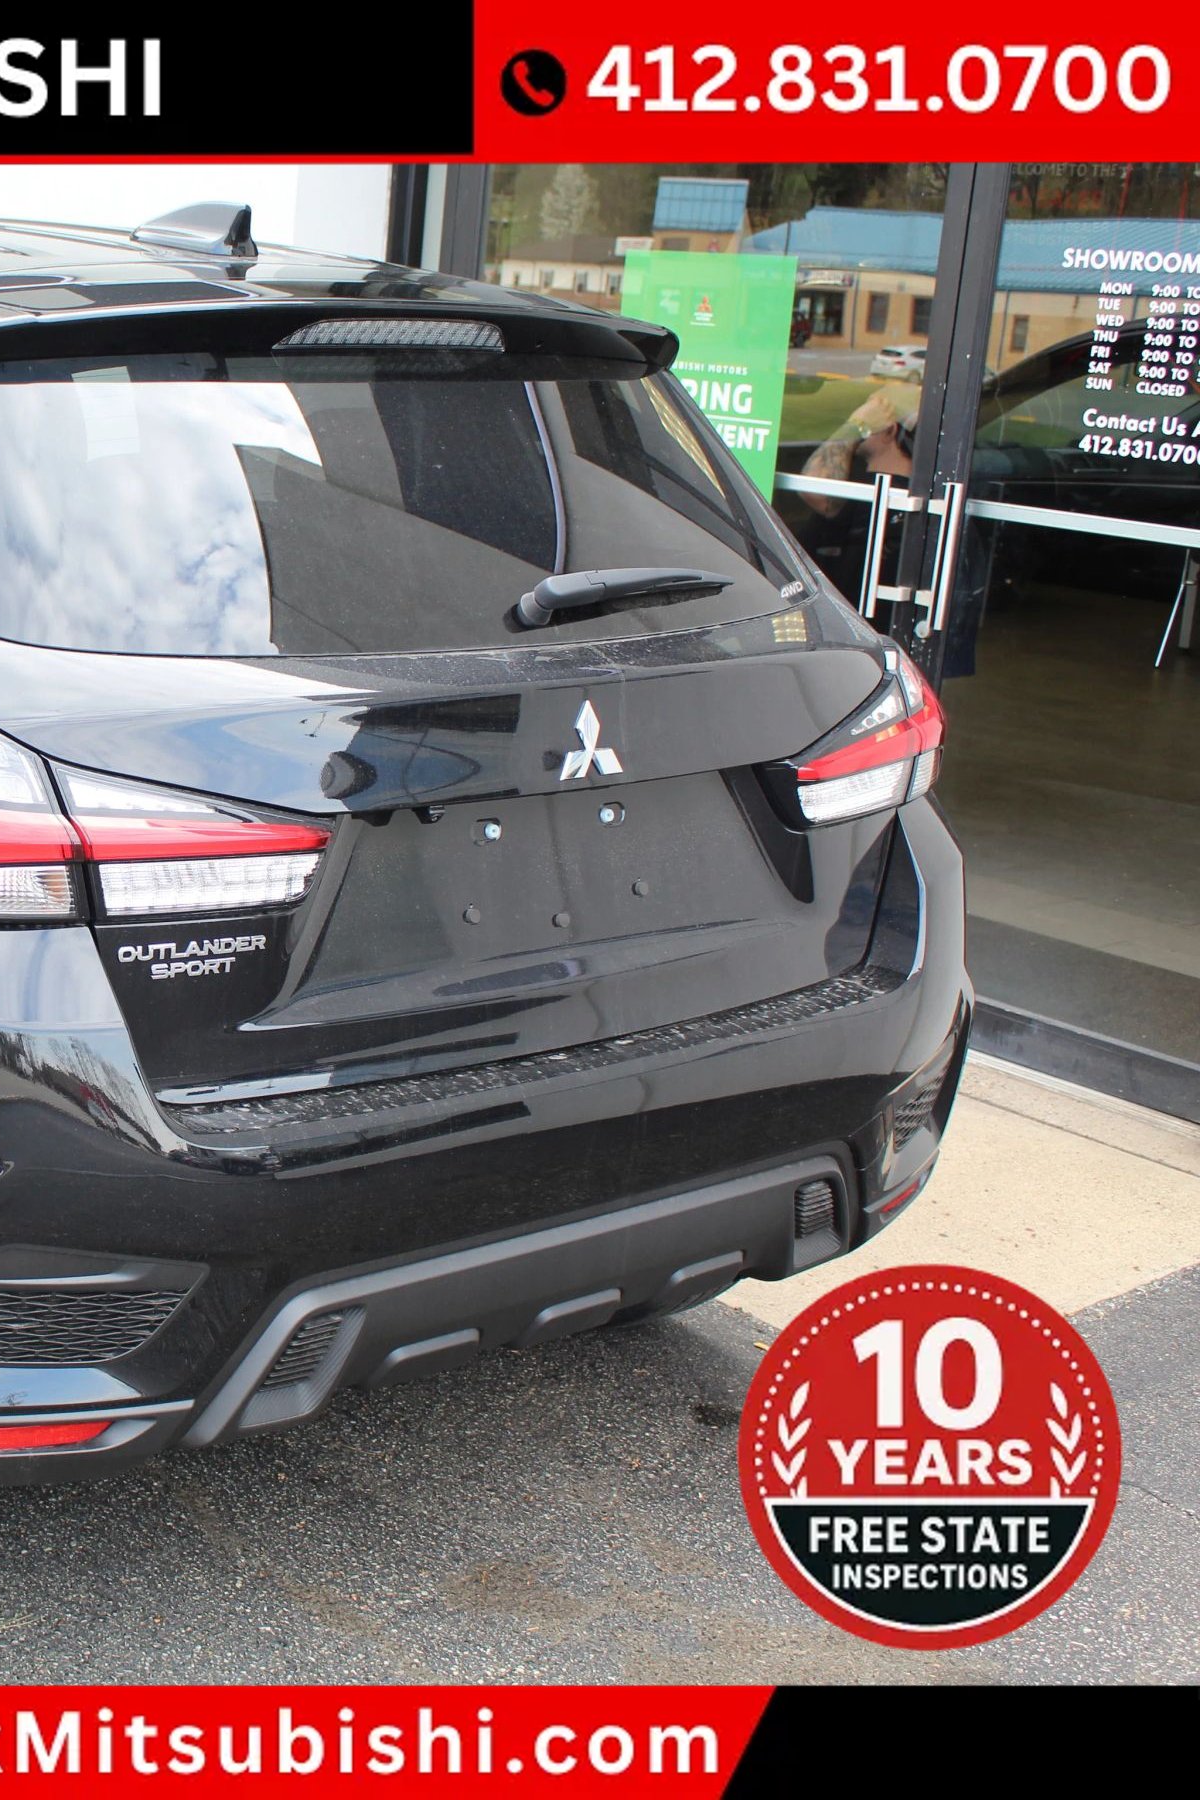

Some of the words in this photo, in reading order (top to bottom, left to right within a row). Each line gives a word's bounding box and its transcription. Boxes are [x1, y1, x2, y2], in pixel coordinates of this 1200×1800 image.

[1062, 248, 1200, 274] SHOWROOM
[1100, 282, 1133, 295] MON
[1151, 284, 1180, 298] 9:00
[1098, 298, 1121, 311] TUE
[1149, 300, 1176, 314] 9:00
[1183, 302, 1200, 316] TO
[1096, 314, 1125, 327] WED
[1146, 317, 1175, 331] 9:00
[1181, 319, 1199, 332] TO
[1093, 330, 1119, 342] THU
[1143, 333, 1172, 347] 9:00
[1178, 335, 1197, 349] TO
[1090, 345, 1111, 358] FRI
[1141, 349, 1170, 363] 9:00
[1175, 351, 1194, 365] TO
[708, 364, 749, 376] MOTORS
[1088, 361, 1112, 374] SAT
[1138, 366, 1166, 379] 9:00
[1171, 368, 1189, 381] TO
[1085, 377, 1113, 390] SUN
[1136, 381, 1186, 397] CLOSED
[1082, 408, 1157, 433] Contact
[1161, 416, 1187, 437] Us
[1079, 434, 1200, 466] 412.831.070
[781, 581, 803, 598] 4WD
[118, 934, 267, 963] OUTLANDER
[151, 957, 236, 980] SPORT
